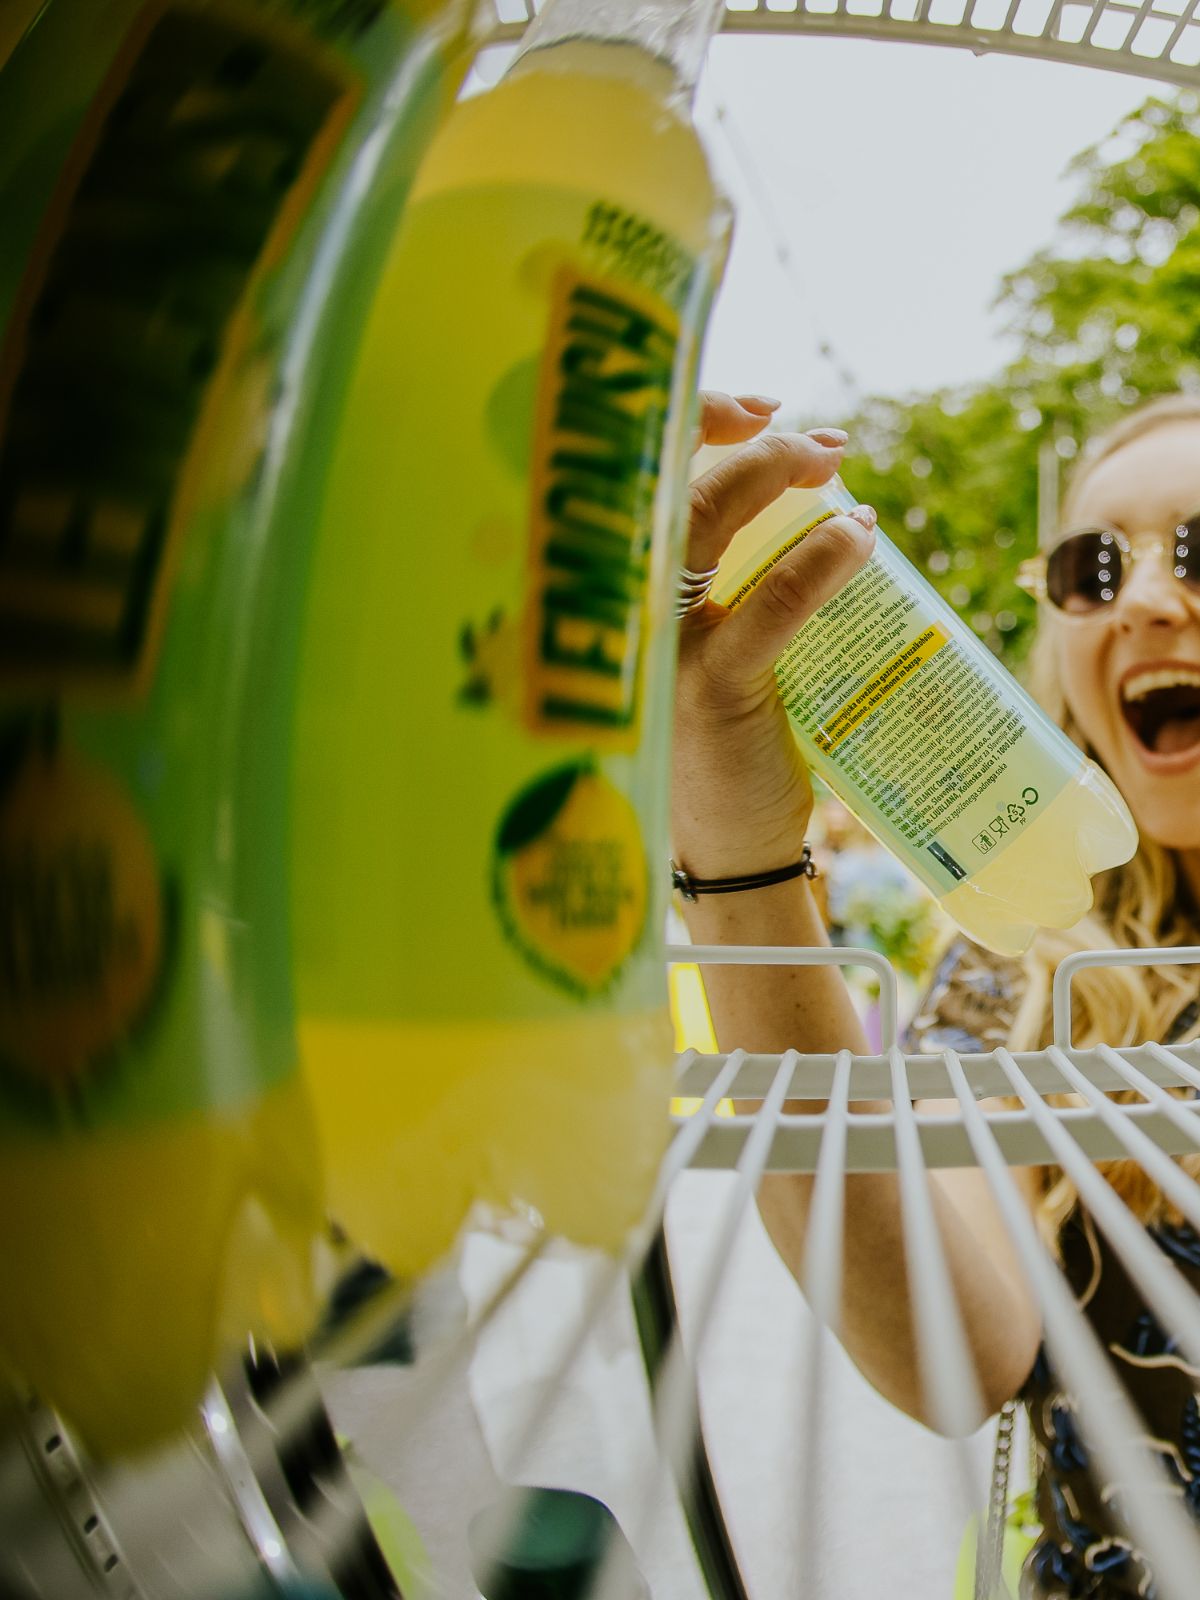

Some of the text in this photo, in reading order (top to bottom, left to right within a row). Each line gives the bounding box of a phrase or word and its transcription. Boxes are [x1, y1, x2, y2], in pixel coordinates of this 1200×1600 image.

[747, 560, 775, 587] gazirano
[815, 597, 840, 621] Najbolje
[836, 573, 866, 601] upotrijebiti
[799, 637, 827, 664] svjetlosti.
[822, 617, 847, 641] Servirati
[843, 601, 865, 622] hladno.
[862, 590, 878, 605] Voćni
[802, 666, 828, 691] ATLANTIC
[824, 651, 845, 672] Droga
[839, 630, 866, 655] Kolinska
[863, 615, 883, 634] d.o.o.,
[879, 598, 902, 620] Kolinska
[805, 624, 825, 643] Čuvati
[827, 604, 847, 624] sobnoj
[843, 582, 874, 610] temperaturi
[810, 651, 826, 667] Prije
[822, 632, 847, 656] upotrebe
[843, 616, 864, 636] lagano
[821, 660, 850, 687] Slovenija.
[848, 633, 878, 661] Distributer
[881, 609, 906, 631] Hrvatsku:
[818, 670, 853, 702] Miramarska
[848, 658, 866, 675] cesta
[862, 650, 875, 663] 23,
[871, 635, 890, 653] 10000
[886, 619, 909, 641] Zagreb.
[840, 662, 880, 699] koncentriranog
[875, 646, 896, 667] voćnog
[893, 638, 906, 651] soka
[847, 703, 871, 725] limone,
[866, 690, 882, 706] okus
[878, 673, 901, 695] limone
[902, 653, 924, 673] bezga.
[853, 677, 881, 704] osvežilna
[876, 656, 906, 683] gazirana
[899, 628, 935, 662] brezalkoholna
[876, 706, 898, 727] dioksid
[893, 697, 908, 711] min.
[917, 669, 939, 689] naravna
[935, 657, 951, 673] aroma
[848, 725, 865, 741] voda,
[860, 707, 883, 729] sladkor,
[879, 693, 897, 710] sadni
[893, 685, 906, 697] sok
[902, 669, 923, 689] limone
[878, 715, 905, 741] aromami,
[901, 695, 926, 718] ekstrakt
[922, 681, 941, 699] bezga
[893, 718, 916, 739] kislina,
[910, 690, 946, 723] antioksidant:
[894, 729, 918, 752] benzoat
[919, 709, 940, 730] kalijev
[934, 694, 955, 714] sorbat,
[880, 760, 901, 780] barvilo:
[896, 749, 912, 764] beta
[908, 730, 933, 753] karoten.
[928, 707, 957, 734] Uporabno
[894, 754, 921, 779] zamašku.
[916, 738, 937, 759] Hraniti
[933, 732, 945, 744] pri
[940, 720, 958, 737] sobni
[906, 762, 927, 782] sončno
[922, 741, 949, 767] svetlobo.
[944, 723, 969, 746] Servirati
[908, 781, 921, 794] dno
[917, 760, 946, 787] plastenke.
[940, 749, 956, 764] Pred
[952, 731, 976, 754] uporabo
[970, 719, 988, 736] nežno
[912, 782, 938, 807] ATLANTIC
[934, 768, 955, 788] Droga
[949, 747, 976, 772] Kolinska
[971, 732, 992, 752] d.o.o.,
[987, 716, 1009, 737] Kolinska
[907, 800, 934, 826] Ljubljana,
[929, 777, 959, 806] Slovenija.
[954, 753, 984, 781] Distributer
[916, 814, 933, 831] d.o.o.
[928, 789, 962, 820] LJUBLJANA,
[956, 768, 983, 794] Kolinska
[978, 757, 995, 773] ulica
[995, 741, 1011, 756] 1000
[947, 788, 980, 820] zgoščenega
[973, 771, 999, 796] sadnega
[993, 761, 1008, 775] soka
